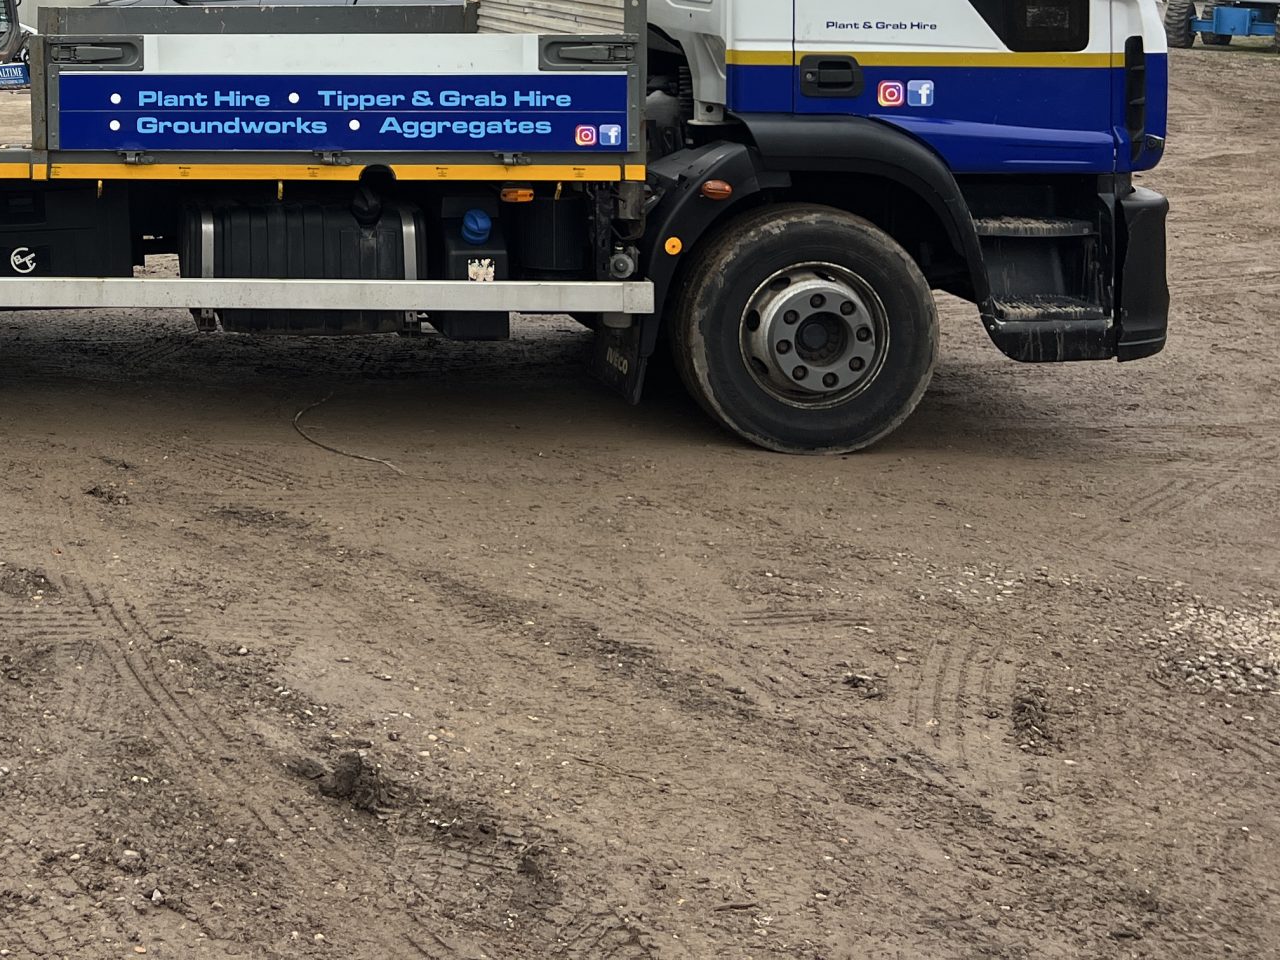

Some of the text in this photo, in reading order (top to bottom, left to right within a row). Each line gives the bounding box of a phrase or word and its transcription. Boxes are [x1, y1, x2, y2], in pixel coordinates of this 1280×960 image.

[826, 21, 937, 30] Plant & Grab Hire
[138, 90, 270, 107] Plant Hire
[317, 90, 571, 111] Tipper & Grab Hire
[136, 116, 328, 134] Groundworks
[379, 117, 552, 138] Aggregates
